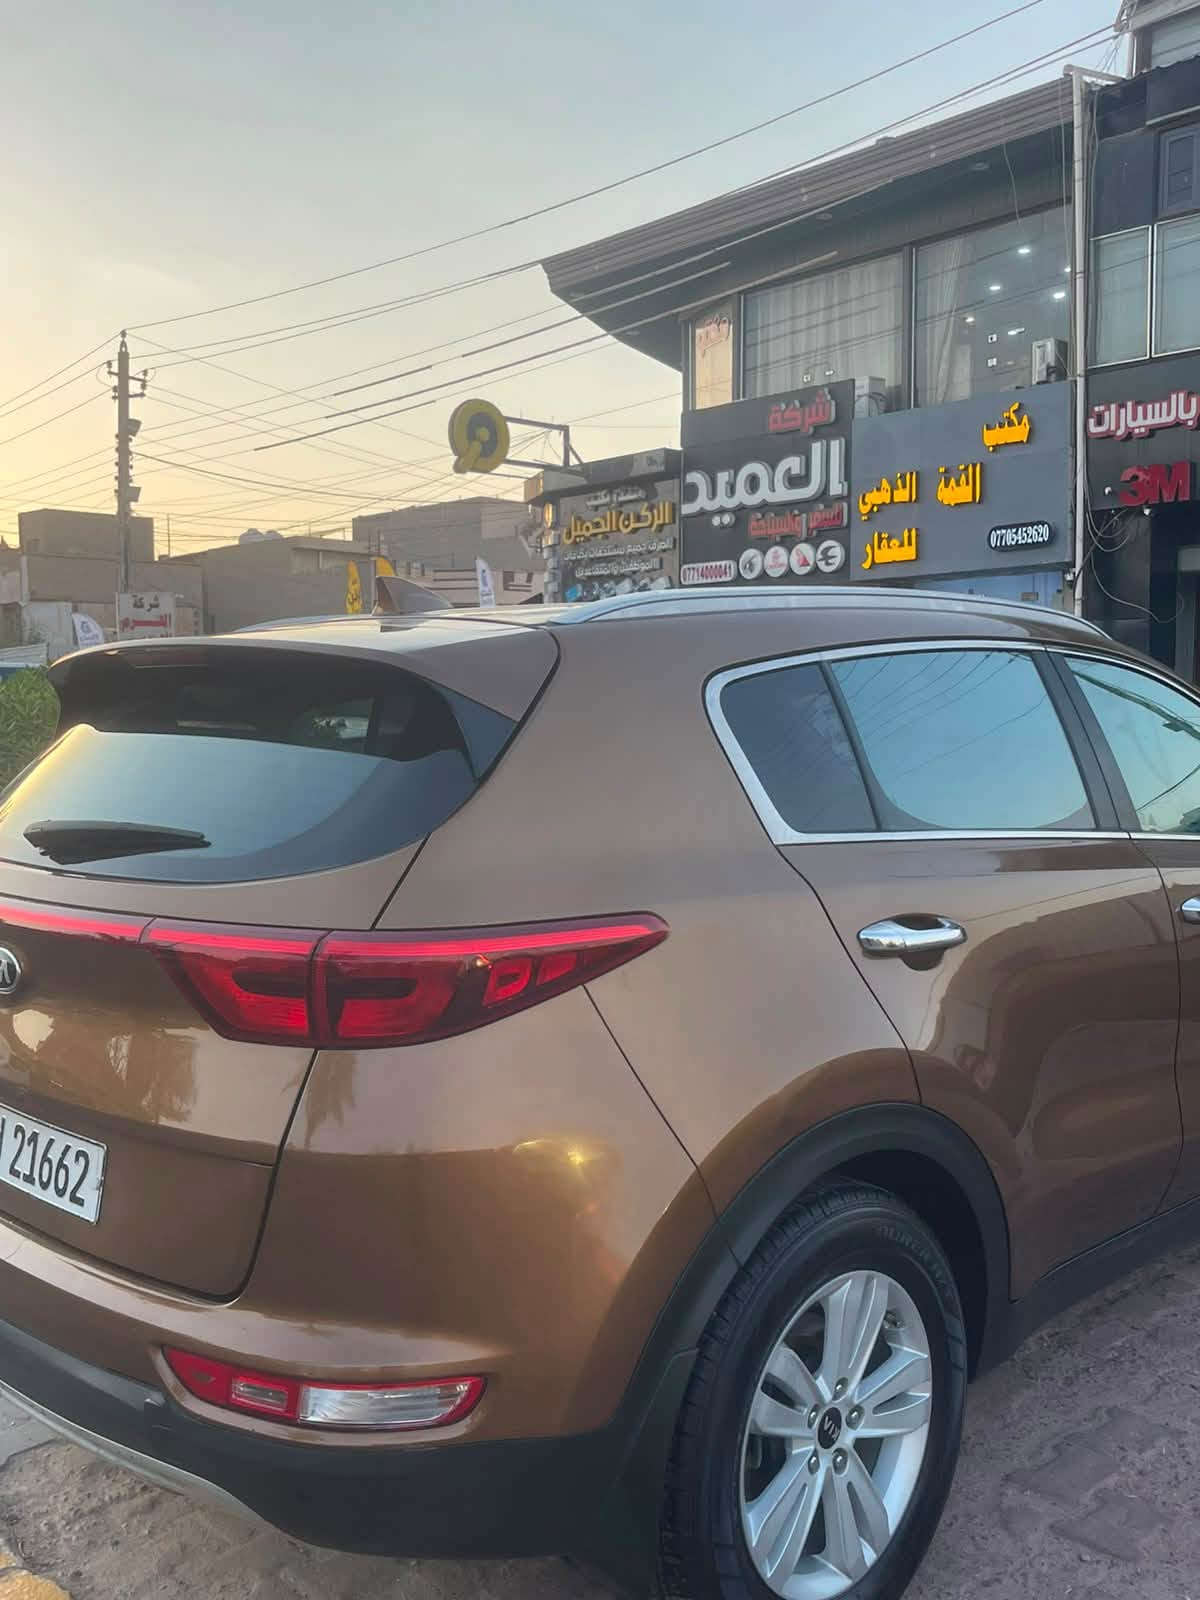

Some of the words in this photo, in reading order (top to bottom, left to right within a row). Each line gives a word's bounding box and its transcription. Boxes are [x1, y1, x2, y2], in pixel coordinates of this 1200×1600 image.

[767, 389, 834, 434] شركة
[982, 401, 1030, 452] مكتب
[1087, 391, 1199, 437] بالسيارات
[681, 438, 846, 526] العميد
[858, 471, 918, 521] الذهبي
[936, 462, 982, 506] القمة
[1119, 461, 1191, 507] 3M
[562, 510, 619, 545] الجميل
[861, 527, 918, 570] للعقار
[990, 524, 1050, 549] 07705452620
[132, 594, 160, 613] شركة
[8, 1123, 90, 1207] 21662
